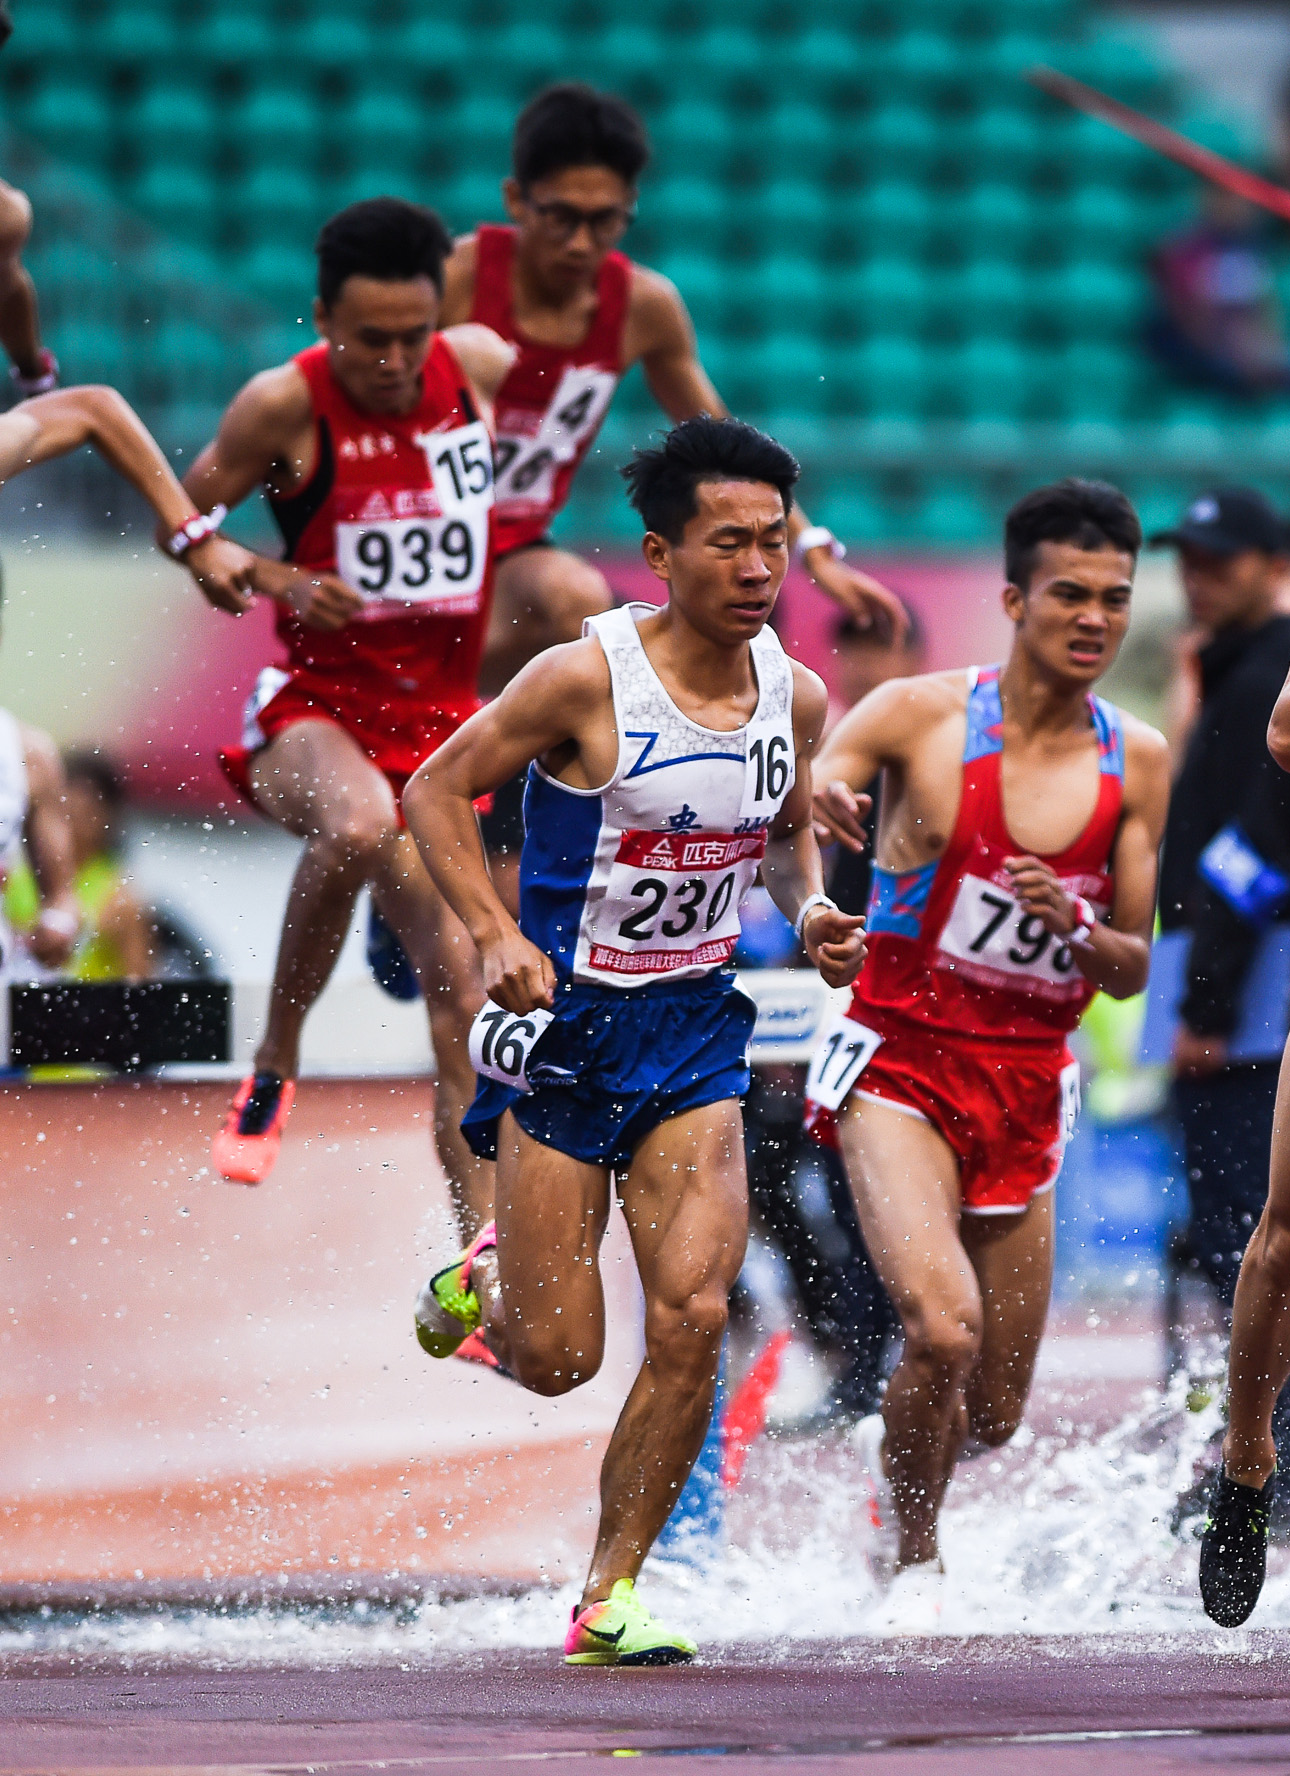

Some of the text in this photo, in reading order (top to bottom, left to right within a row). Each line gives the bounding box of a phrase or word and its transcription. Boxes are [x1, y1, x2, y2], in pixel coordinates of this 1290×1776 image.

[437, 439, 492, 500] 15
[356, 518, 475, 592] 939
[750, 735, 789, 802] 16
[642, 854, 680, 869] PEAK
[618, 871, 736, 941] 230
[480, 1010, 537, 1077] 16
